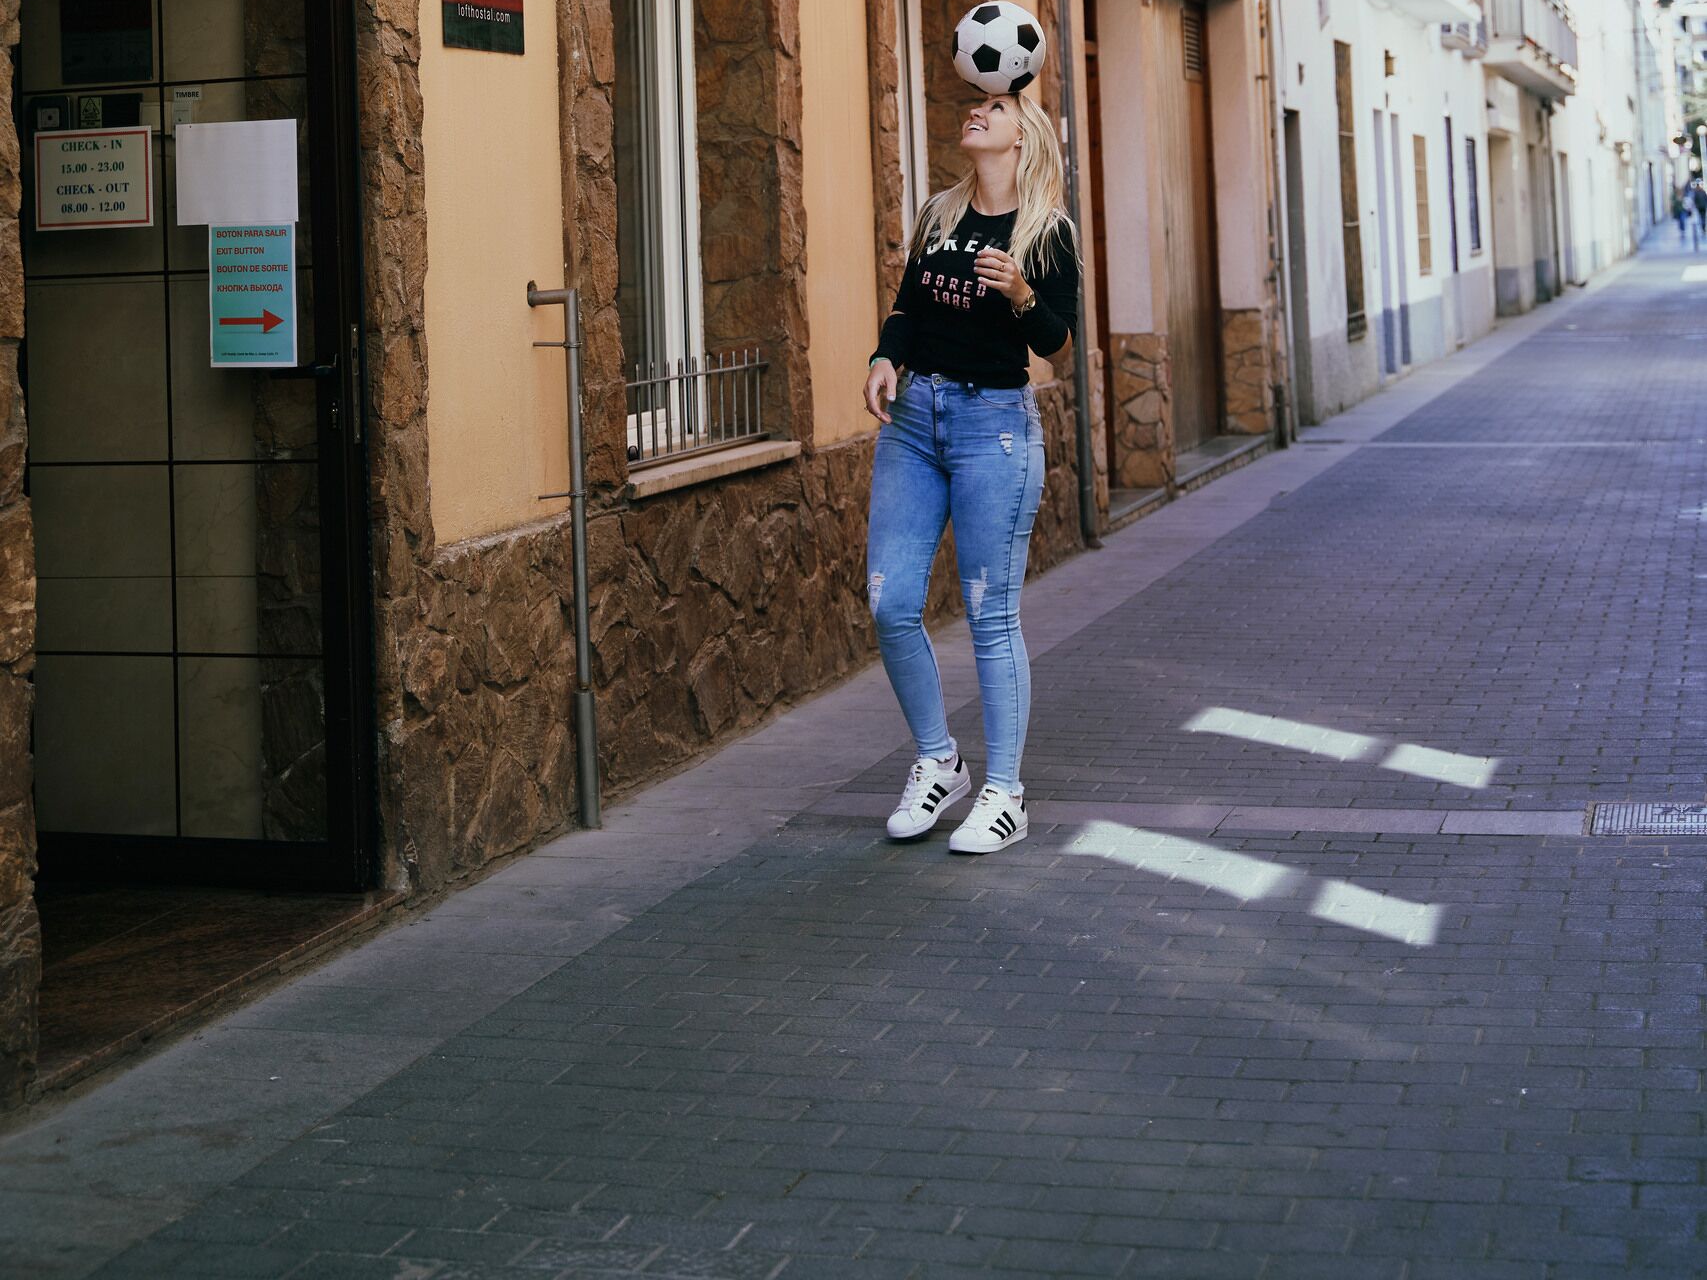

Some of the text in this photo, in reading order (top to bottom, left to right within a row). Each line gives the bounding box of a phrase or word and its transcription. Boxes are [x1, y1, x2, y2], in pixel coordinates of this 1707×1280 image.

[457, 3, 511, 24] lofthostal.com
[61, 140, 100, 152] CHECK
[111, 139, 122, 150] IN
[61, 163, 87, 174] 15.00
[97, 161, 125, 172] 23.00
[56, 184, 95, 196] CHECK
[105, 182, 130, 193] OUT
[61, 202, 88, 213] 08.00
[99, 201, 125, 212] 12.00
[216, 230, 242, 238] BOTON
[265, 229, 287, 237] SALIR
[216, 247, 265, 255] EXIT BUTTON
[216, 265, 248, 273] BOUTON
[261, 264, 289, 272] SORTIE
[921, 271, 987, 297] BORED
